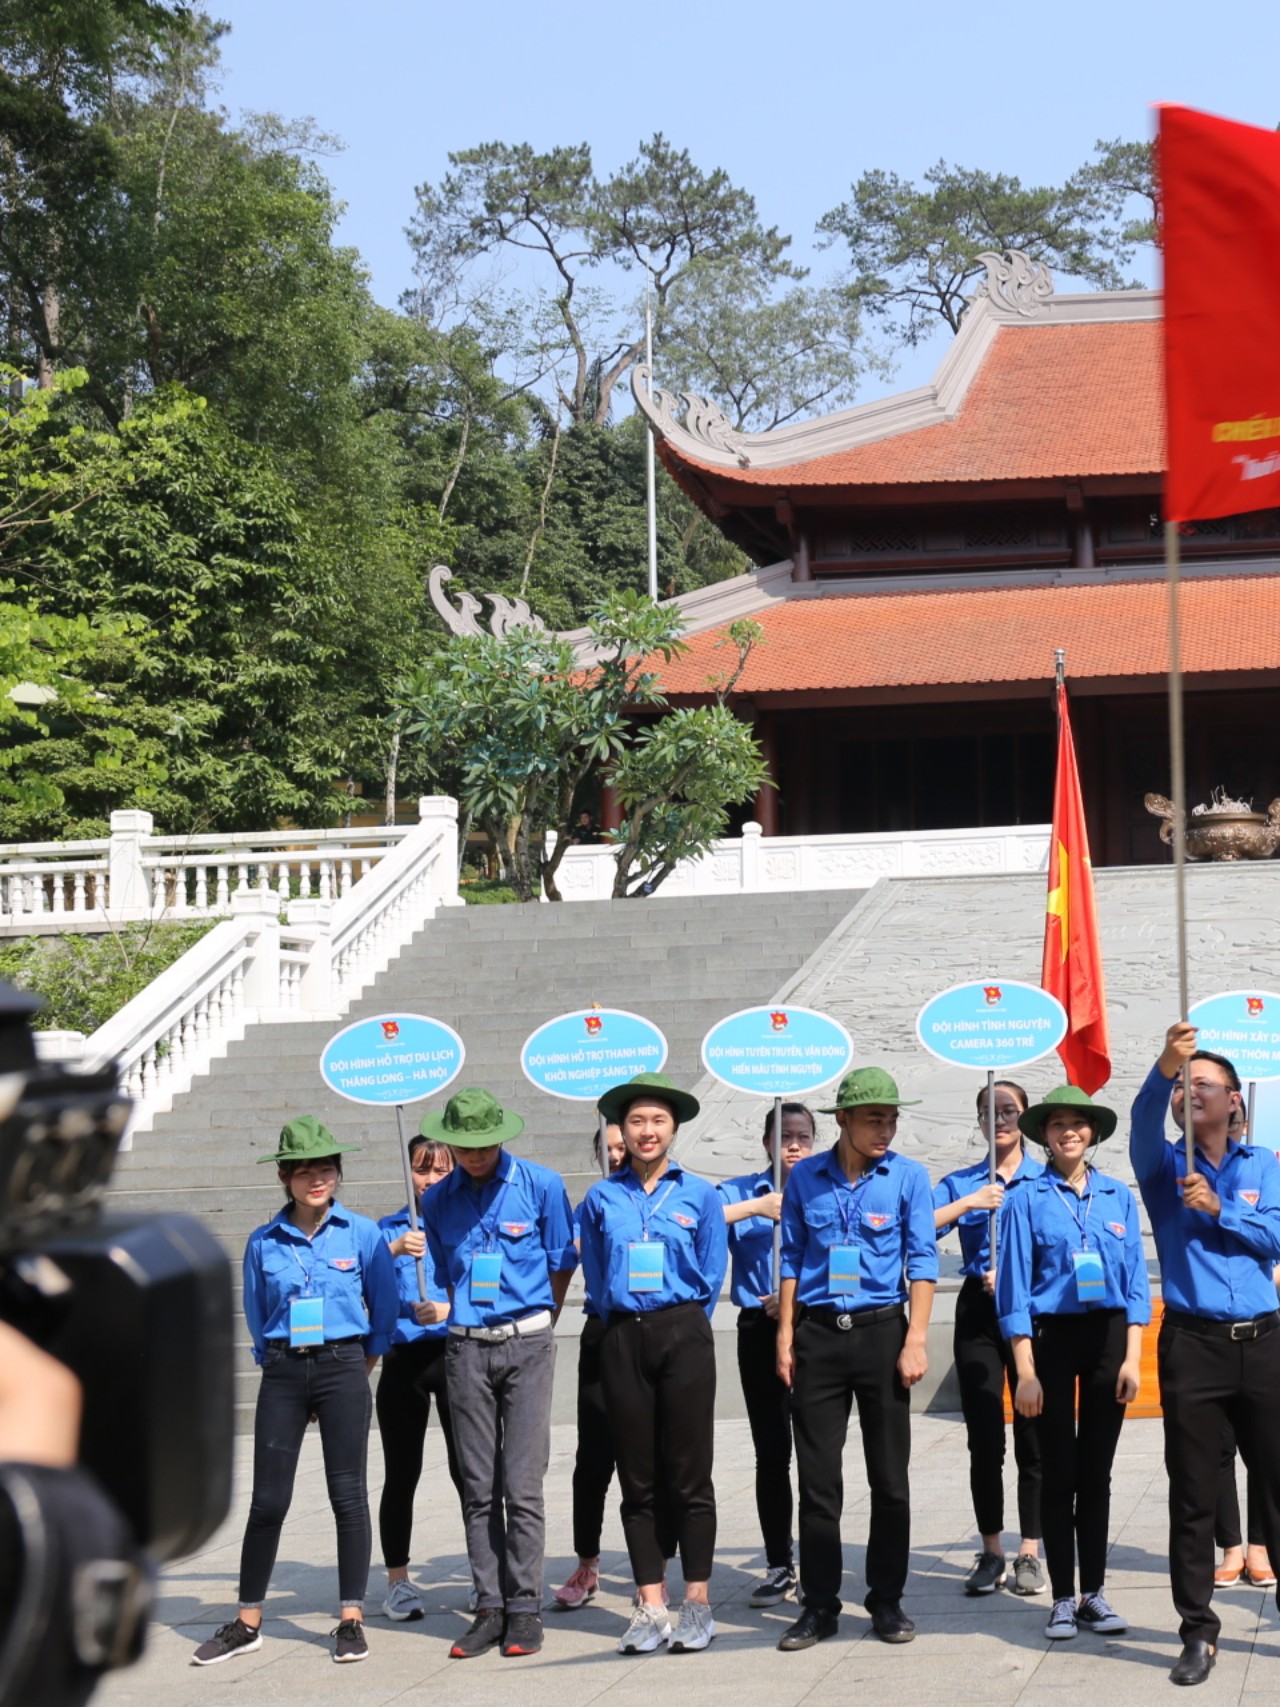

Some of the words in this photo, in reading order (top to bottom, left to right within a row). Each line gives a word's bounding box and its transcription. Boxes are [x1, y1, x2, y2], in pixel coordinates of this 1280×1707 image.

[932, 1022, 952, 1034] ĐỘI
[954, 1020, 979, 1032] HÌNH
[981, 1018, 1006, 1030] TÌNH
[1008, 1017, 1052, 1032] NGUYỆN
[950, 1039, 993, 1050] CAMERA
[995, 1038, 1014, 1049] 360
[1016, 1034, 1035, 1047] TRẺ
[1200, 1029, 1220, 1043] ĐỘI
[1222, 1029, 1248, 1041] HÌNH
[1250, 1030, 1270, 1042] XÂY
[529, 1055, 546, 1067] ĐỘI
[547, 1052, 570, 1064] HÌNH
[586, 1050, 604, 1063] TRỢ
[605, 1048, 636, 1060] THANH
[638, 1044, 659, 1057] NIÊN
[709, 1047, 723, 1059] ĐỘI
[725, 1046, 744, 1057] HÌNH
[822, 1045, 846, 1059] ĐỘNG
[1241, 1047, 1270, 1060] THÔN
[330, 1060, 348, 1073] ĐỘI
[350, 1057, 376, 1070] HÌNH
[377, 1053, 392, 1067] HỖ
[394, 1053, 413, 1067] TRỢ
[415, 1053, 430, 1063] DU
[431, 1049, 454, 1062] LỊCH
[377, 1073, 404, 1084] LONG
[412, 1070, 427, 1080] HÀ
[429, 1068, 448, 1079] NỘI
[568, 1066, 600, 1080] NGHIỆP
[602, 1065, 627, 1077] SÁNG
[752, 1062, 770, 1074] MÁU
[771, 1062, 789, 1074] TÌNH
[790, 1063, 823, 1076] NGUYỆN
